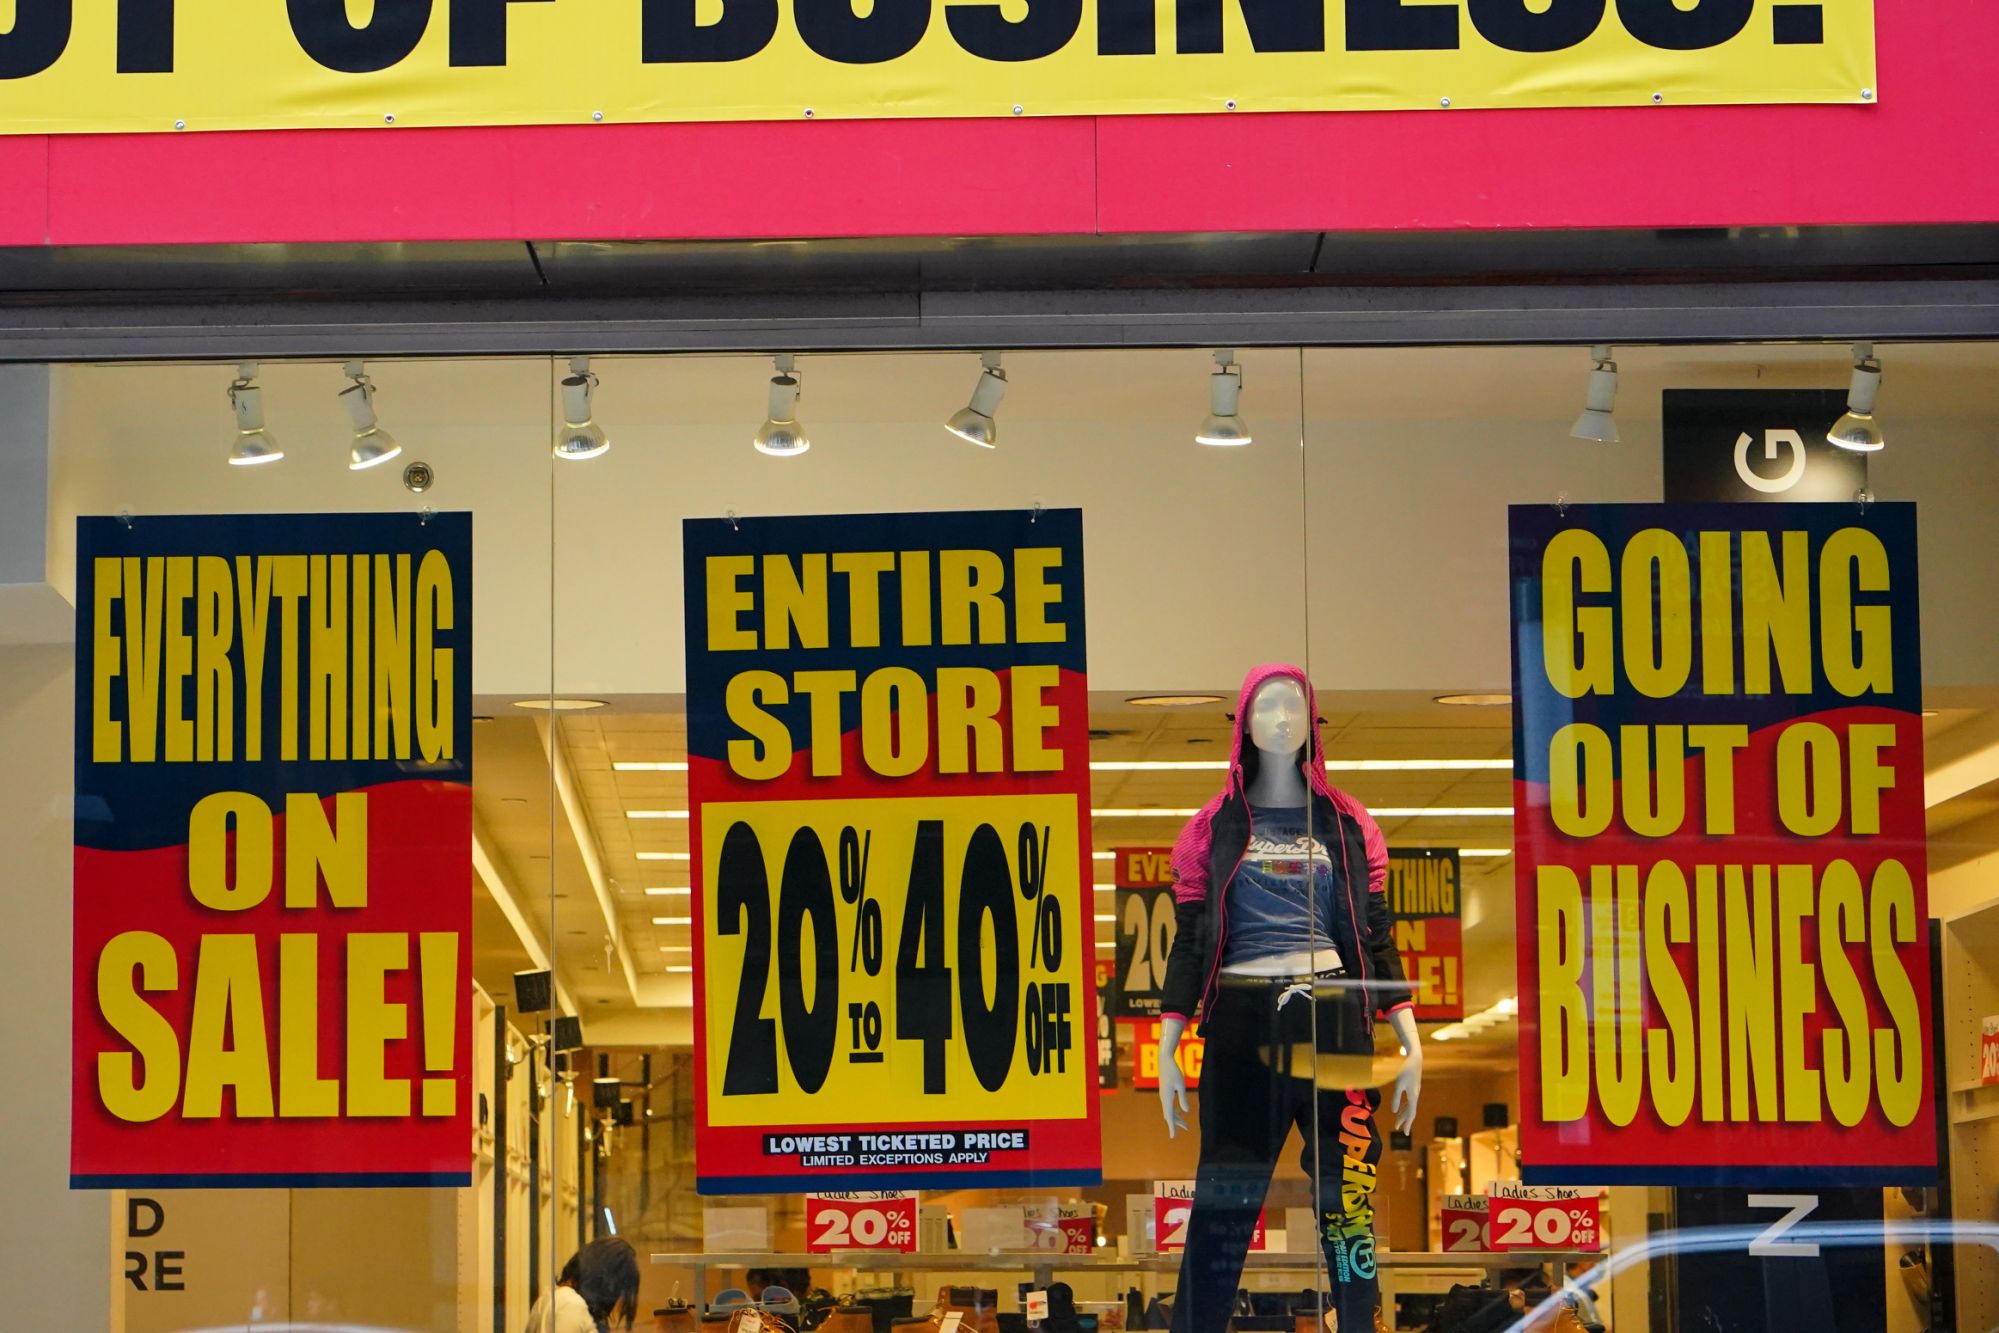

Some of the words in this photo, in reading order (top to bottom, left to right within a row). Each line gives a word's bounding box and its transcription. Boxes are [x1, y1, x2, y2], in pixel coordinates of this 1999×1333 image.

[93, 549, 454, 765] EVERYTHING
[706, 547, 1066, 652] ENTIRE
[1542, 527, 1893, 698] GOING
[724, 664, 1064, 782] STORE
[1549, 723, 1749, 837] OUT
[1777, 721, 1896, 836] OF
[188, 791, 368, 912] ON
[717, 820, 883, 1096] 20%
[848, 1001, 884, 1063] TO
[896, 820, 1062, 1094] 40%
[1025, 981, 1071, 1077] OFF
[1391, 920, 1427, 952] N
[1537, 858, 1923, 1128] BUSINESS
[97, 930, 460, 1124] SALE!
[769, 1136, 851, 1153] LOWEST
[859, 1134, 956, 1151] TICKETED
[964, 1132, 1025, 1149] PRICE
[803, 1154, 854, 1166] LIMITED
[859, 1153, 943, 1165] EXCEPTIONS
[949, 1152, 987, 1163] APPLY
[1494, 1182, 1538, 1199] Ladies
[1545, 1187, 1581, 1200] Shoes
[812, 1209, 911, 1245] 20%
[887, 1231, 911, 1245] OFF
[1495, 1207, 1594, 1244] 20%
[1571, 1230, 1595, 1243] OFF
